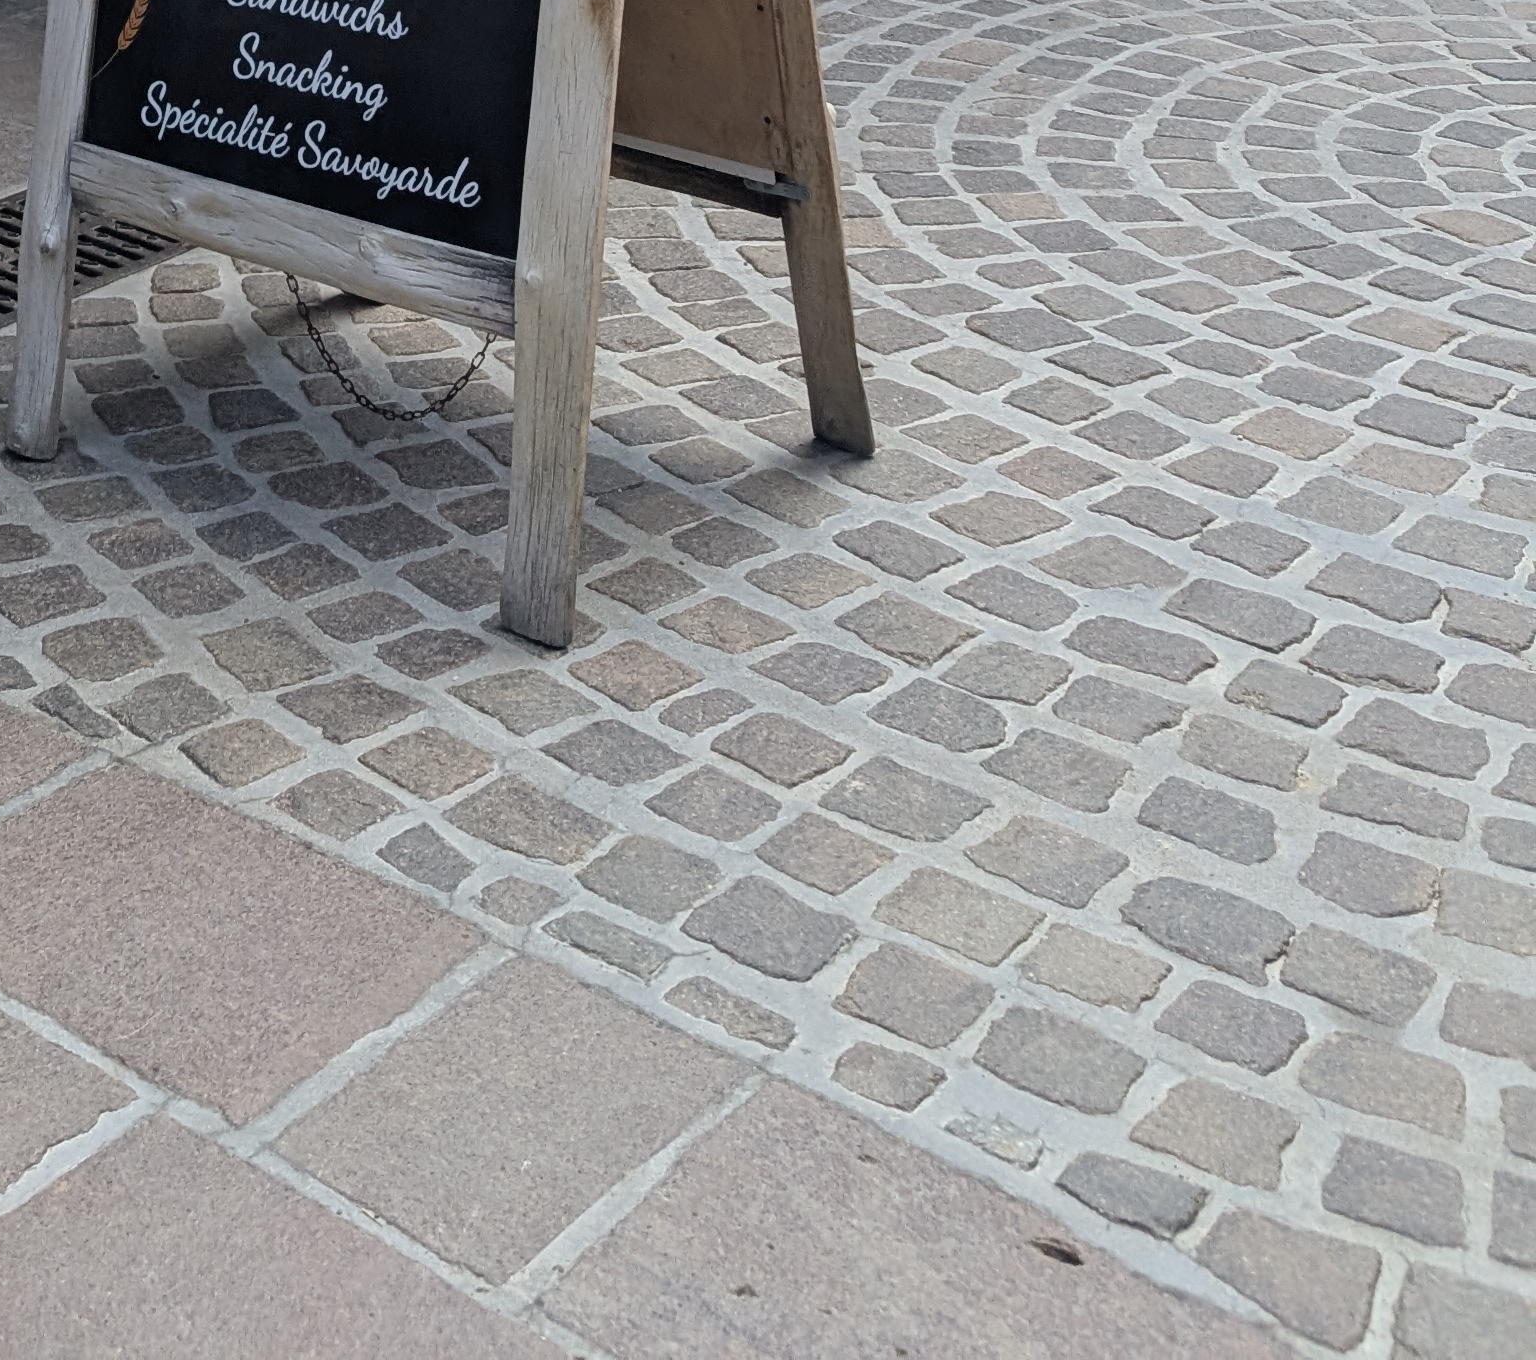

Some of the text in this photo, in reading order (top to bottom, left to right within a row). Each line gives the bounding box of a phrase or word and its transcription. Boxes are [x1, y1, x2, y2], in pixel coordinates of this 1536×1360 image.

[232, 32, 388, 121] Snacking
[140, 81, 481, 208] Spécialité Savoyarde
